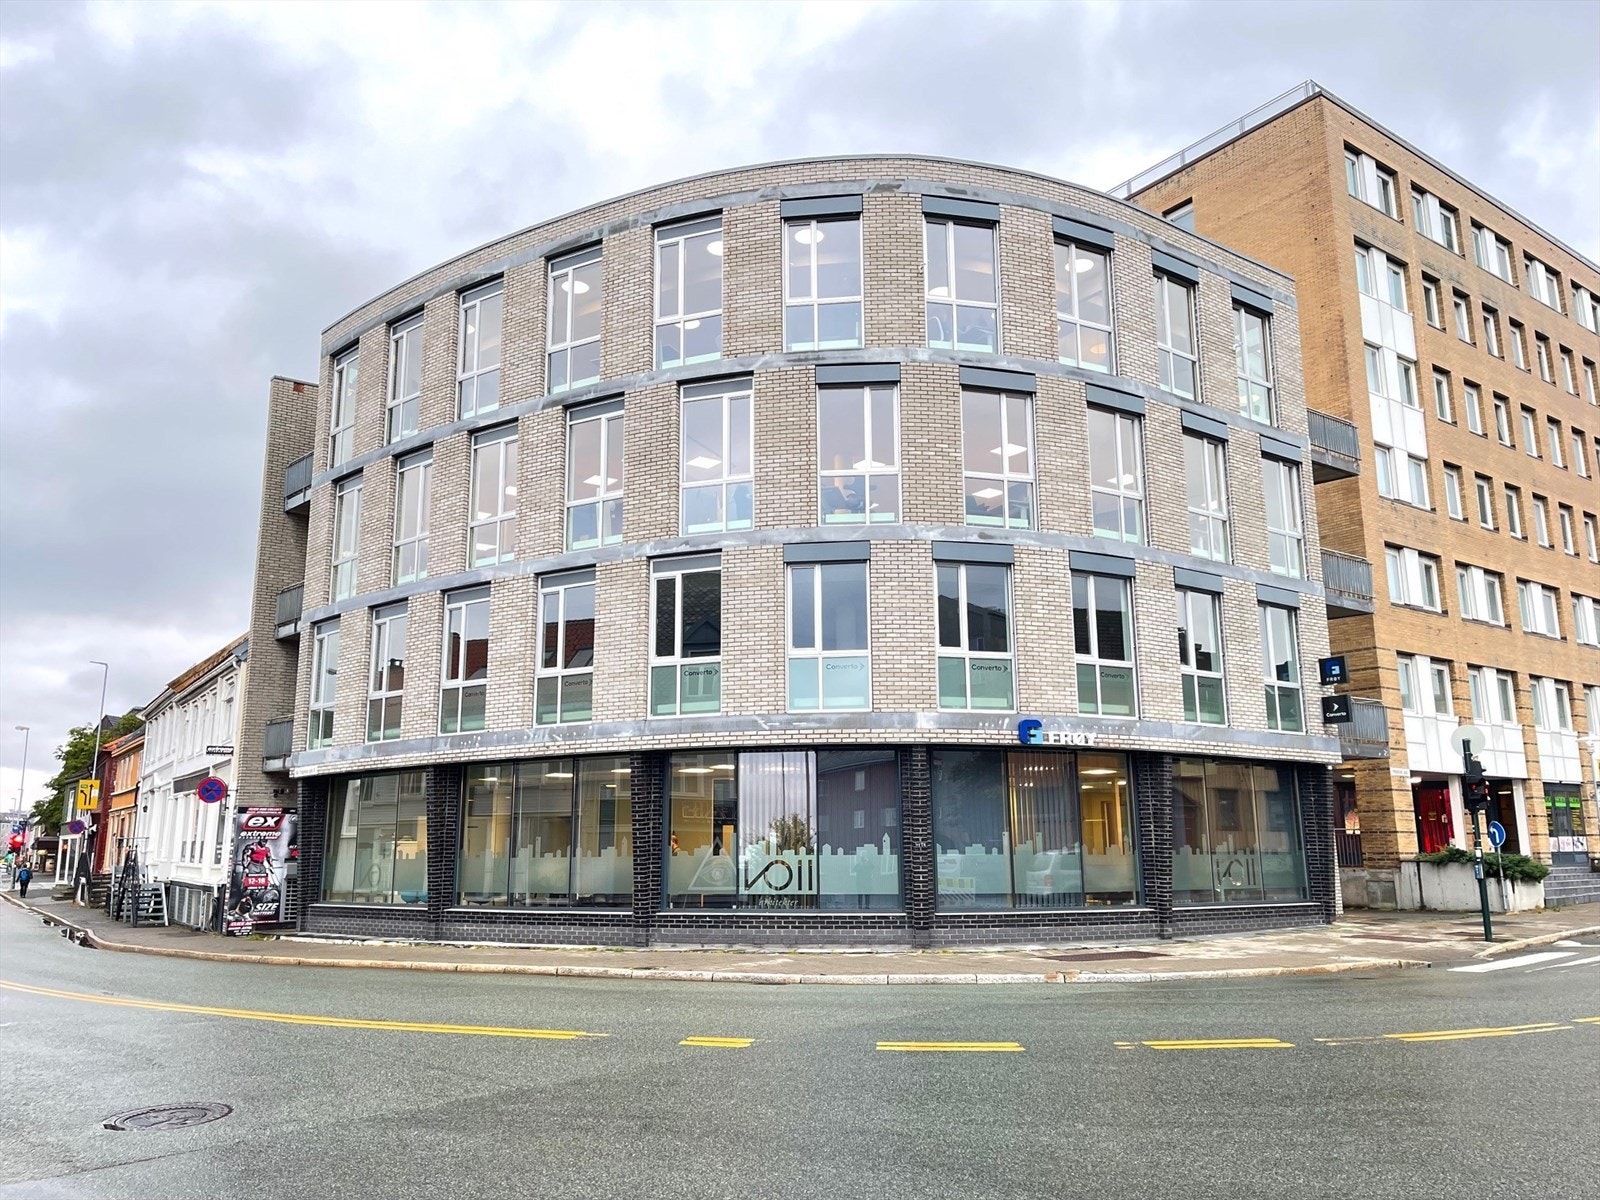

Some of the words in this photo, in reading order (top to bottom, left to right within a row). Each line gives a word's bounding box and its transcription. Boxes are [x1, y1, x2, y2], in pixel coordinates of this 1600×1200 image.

[971, 664, 1002, 672] Converto
[683, 669, 713, 677] Converto
[1100, 671, 1125, 680] Converto
[246, 815, 280, 828] ex
[255, 902, 280, 911] SIZE
